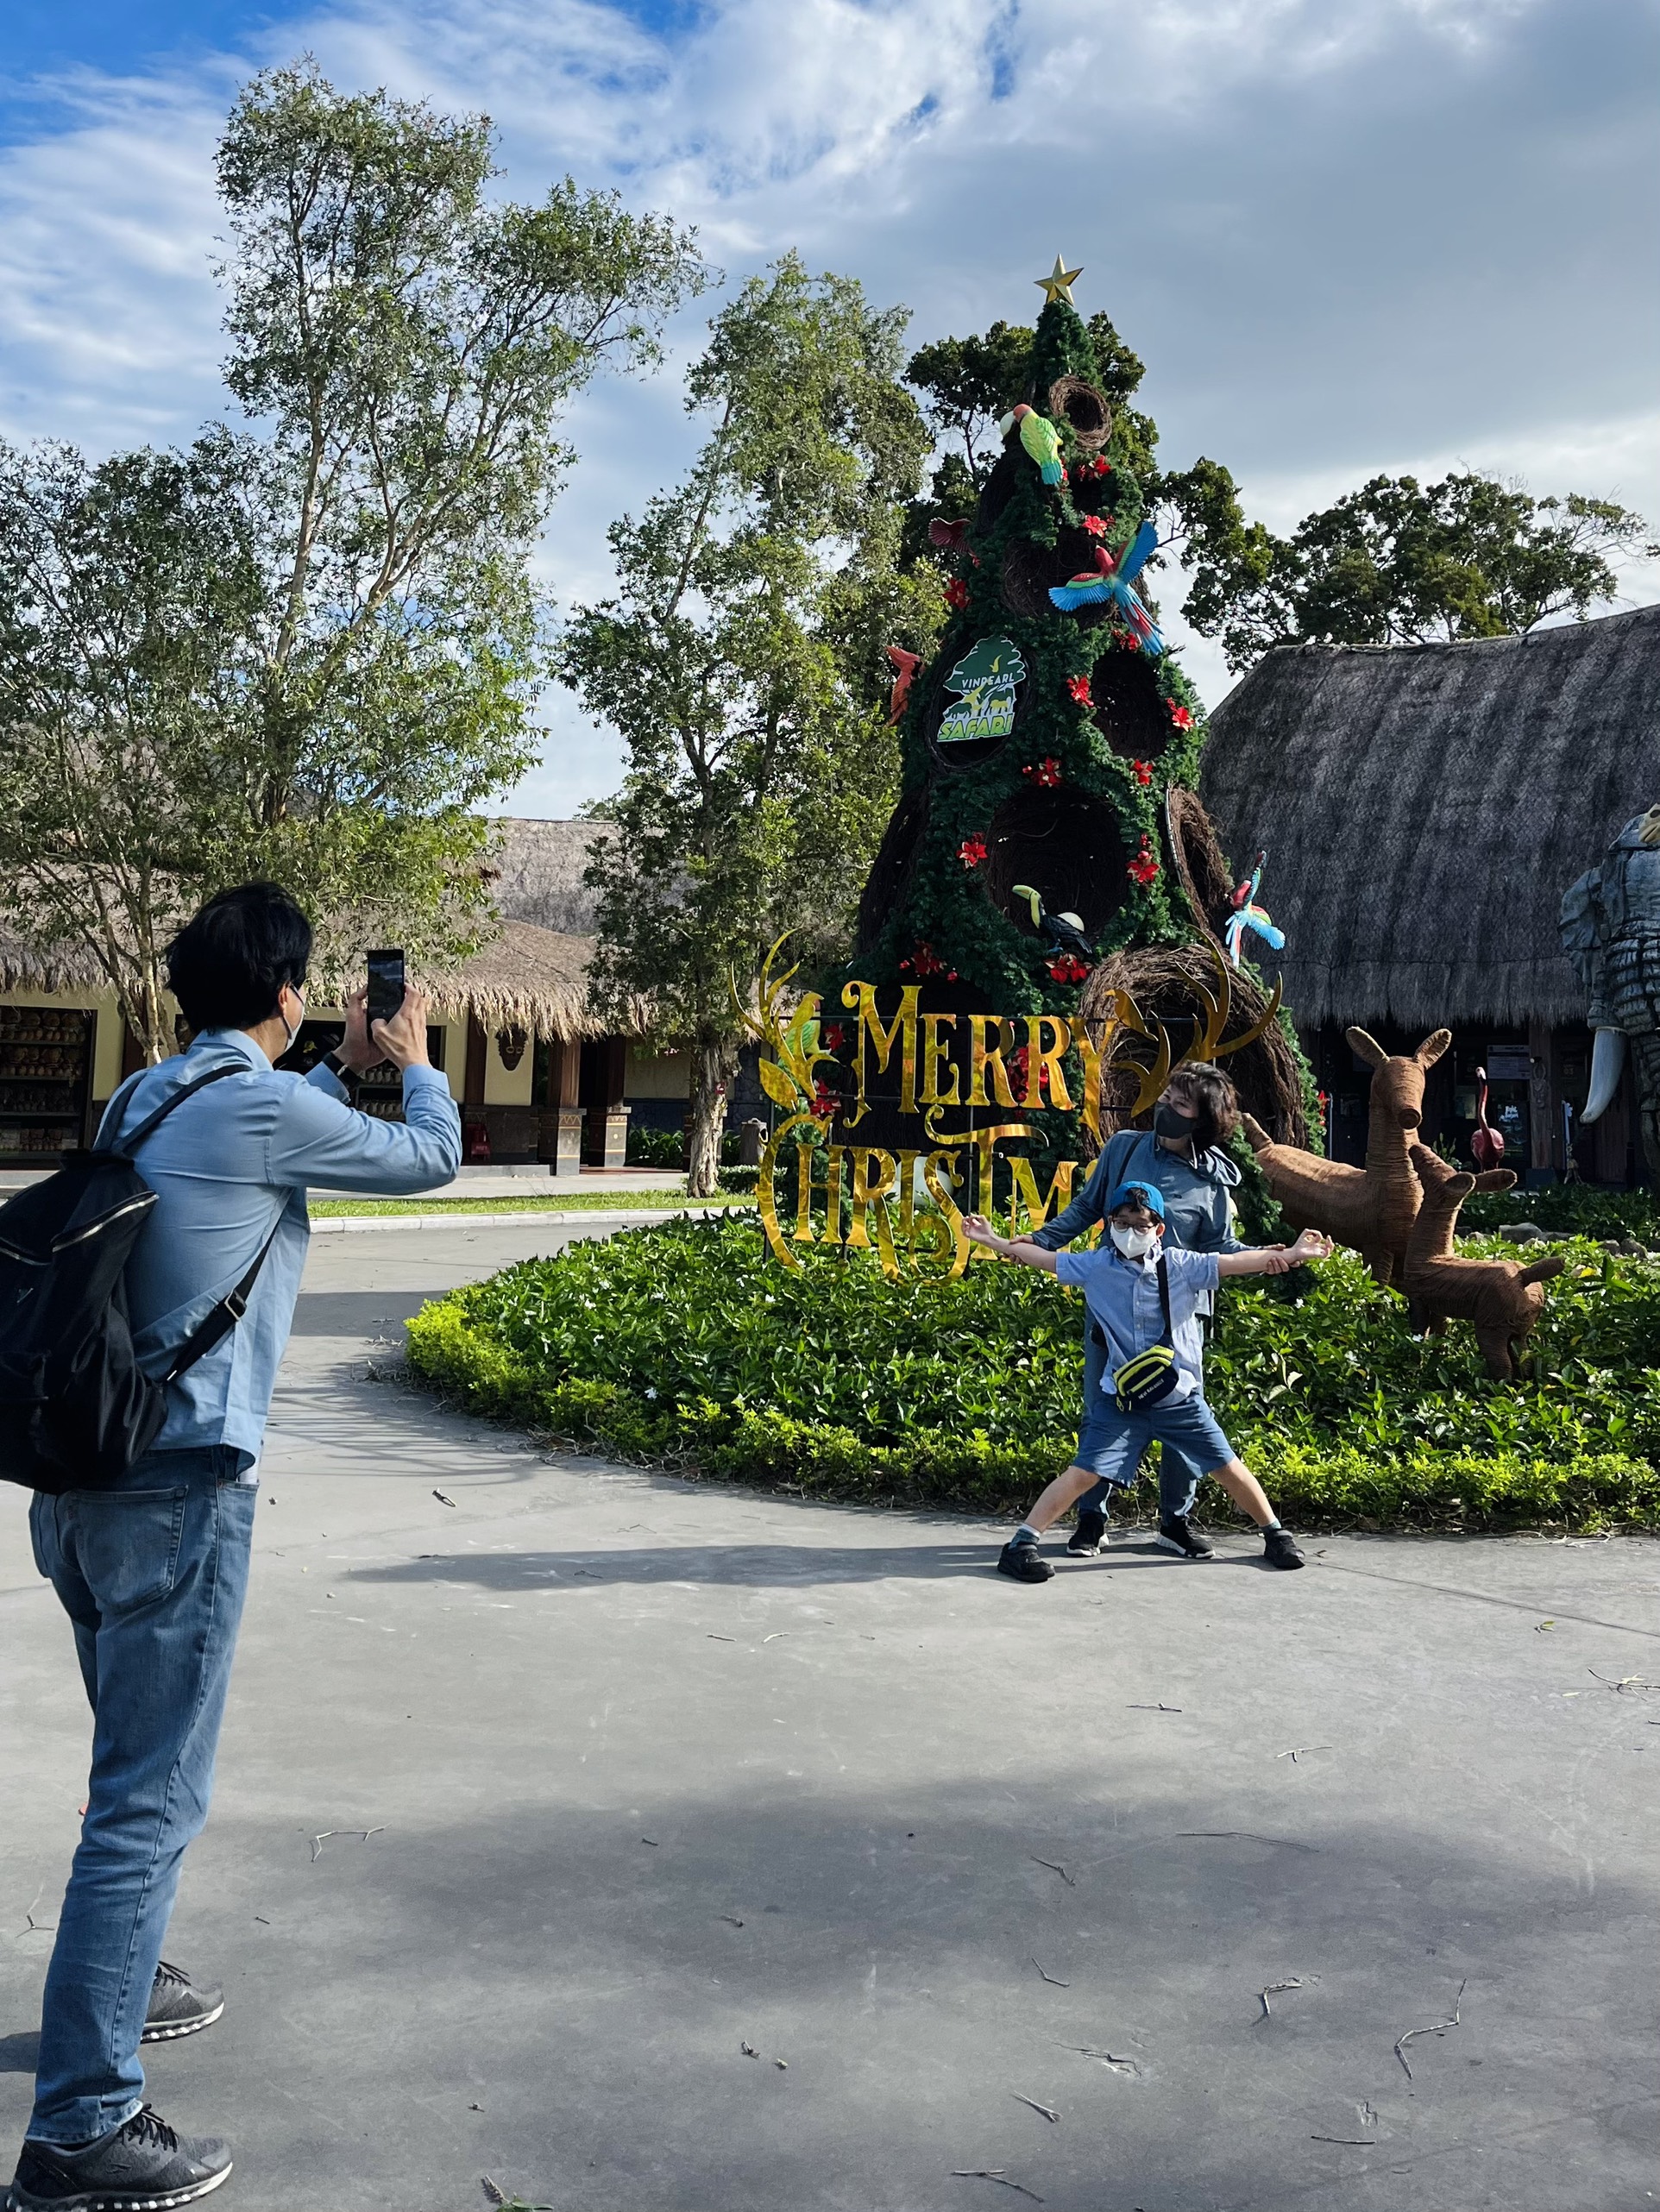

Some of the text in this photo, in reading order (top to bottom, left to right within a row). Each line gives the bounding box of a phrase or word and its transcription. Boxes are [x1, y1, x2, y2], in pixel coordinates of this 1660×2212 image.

[939, 713, 1013, 740] SAFARI
[961, 672, 1015, 689] VINPEARL
[841, 980, 1117, 1148] MERRY
[755, 1103, 1105, 1294] CHRISTM
